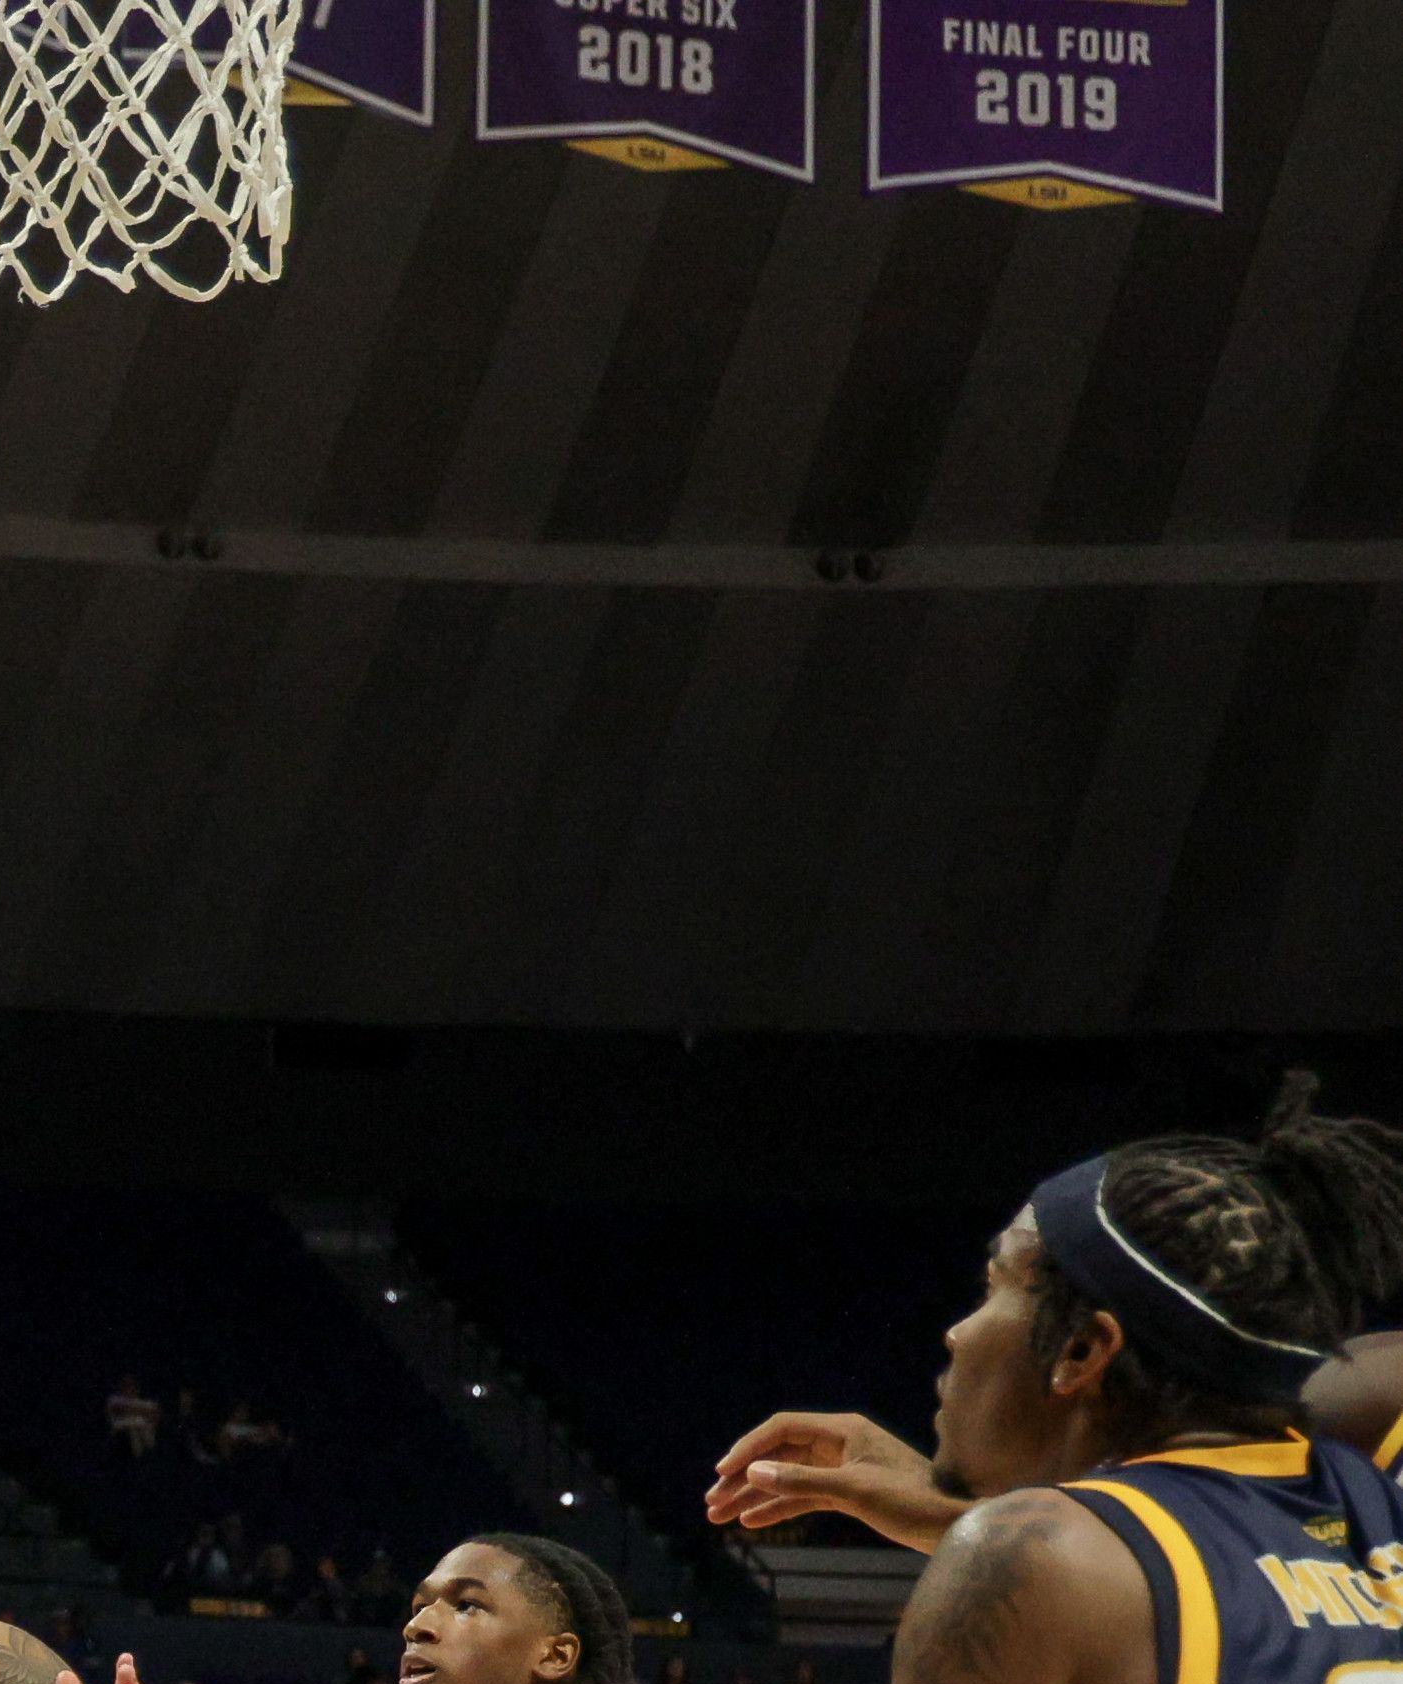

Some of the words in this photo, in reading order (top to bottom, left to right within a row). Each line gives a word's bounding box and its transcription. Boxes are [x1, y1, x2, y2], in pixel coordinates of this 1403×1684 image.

[577, 24, 714, 95] 2018
[943, 18, 1043, 60] FINAL
[1057, 26, 1152, 66] FOUR
[976, 69, 1117, 131] 2019
